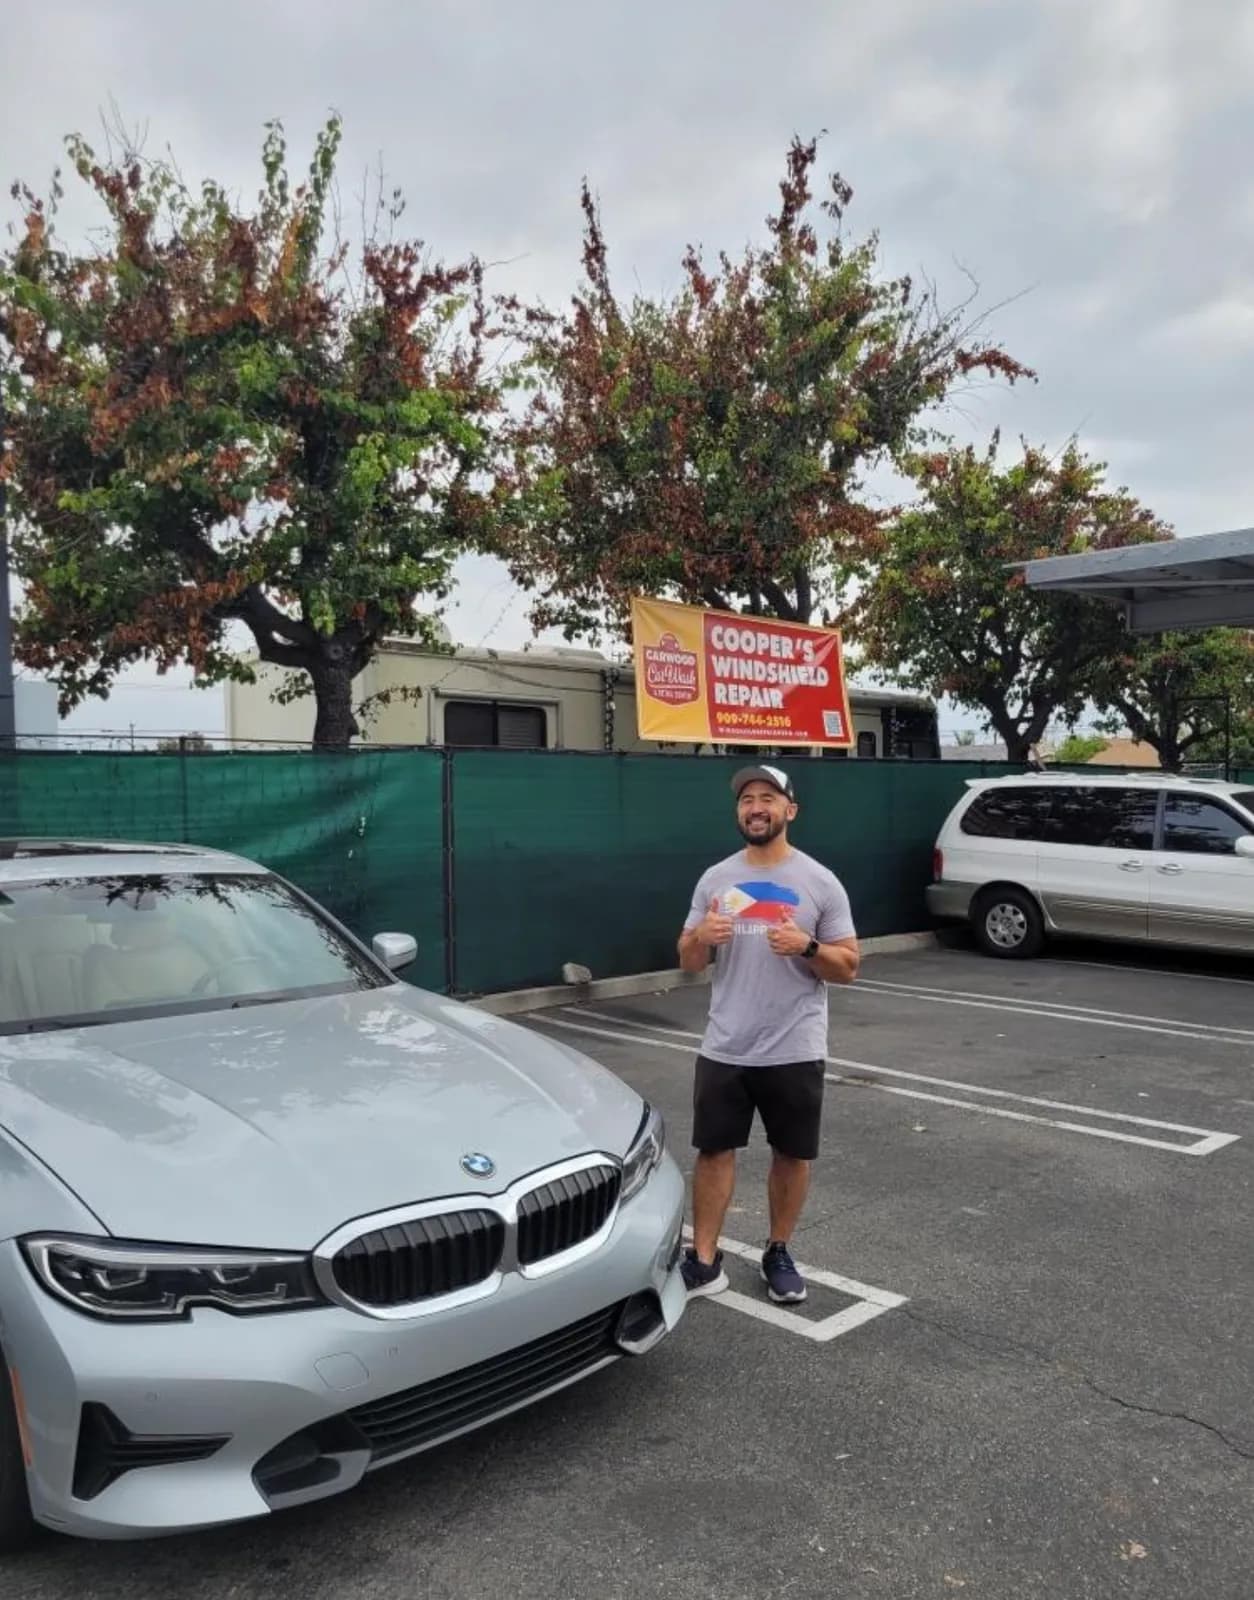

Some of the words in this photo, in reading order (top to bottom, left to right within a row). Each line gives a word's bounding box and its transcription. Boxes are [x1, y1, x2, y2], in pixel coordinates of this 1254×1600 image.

[711, 624, 816, 663] COOPER'S
[711, 655, 829, 688] WINDSHIELD
[714, 682, 784, 709] REPAIR
